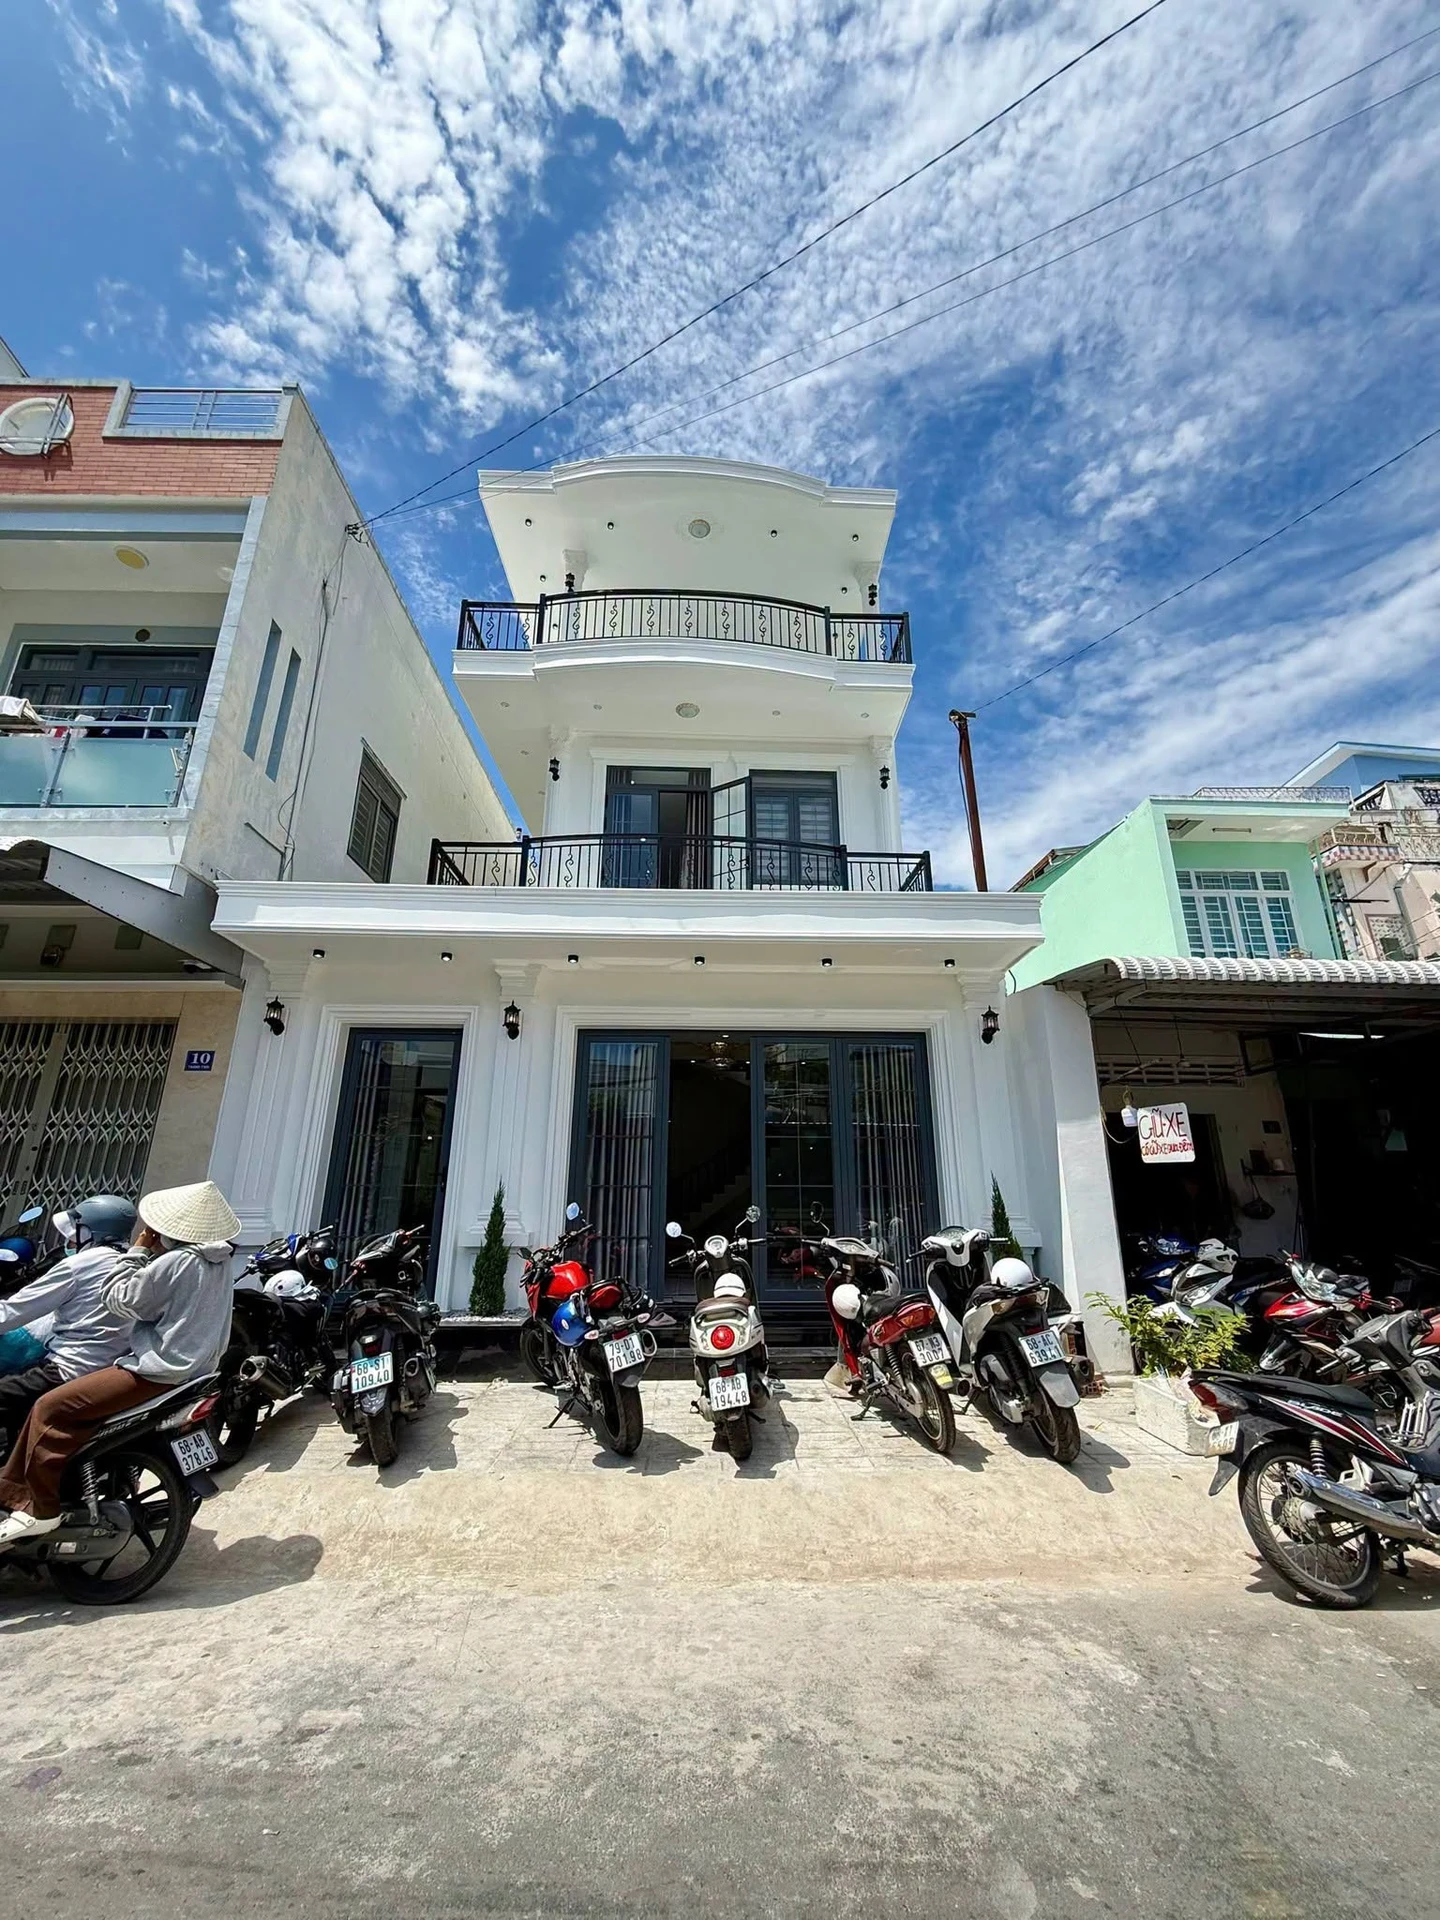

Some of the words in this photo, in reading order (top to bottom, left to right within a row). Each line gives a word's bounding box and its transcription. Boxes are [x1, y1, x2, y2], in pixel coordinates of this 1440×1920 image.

[190, 1052, 211, 1065] 10
[609, 1337, 636, 1356] 79-D1
[1026, 1334, 1054, 1350] 68-AC
[609, 1349, 643, 1371] 701.98
[919, 1348, 945, 1363] 3007
[1028, 1346, 1063, 1364] 639.41
[357, 1358, 385, 1376] 68-S1
[355, 1370, 390, 1390] 109.40
[716, 1379, 741, 1392] 68-AB
[714, 1391, 748, 1406] 194.48
[177, 1434, 205, 1455] 68-AB
[182, 1447, 214, 1472] 378.46
